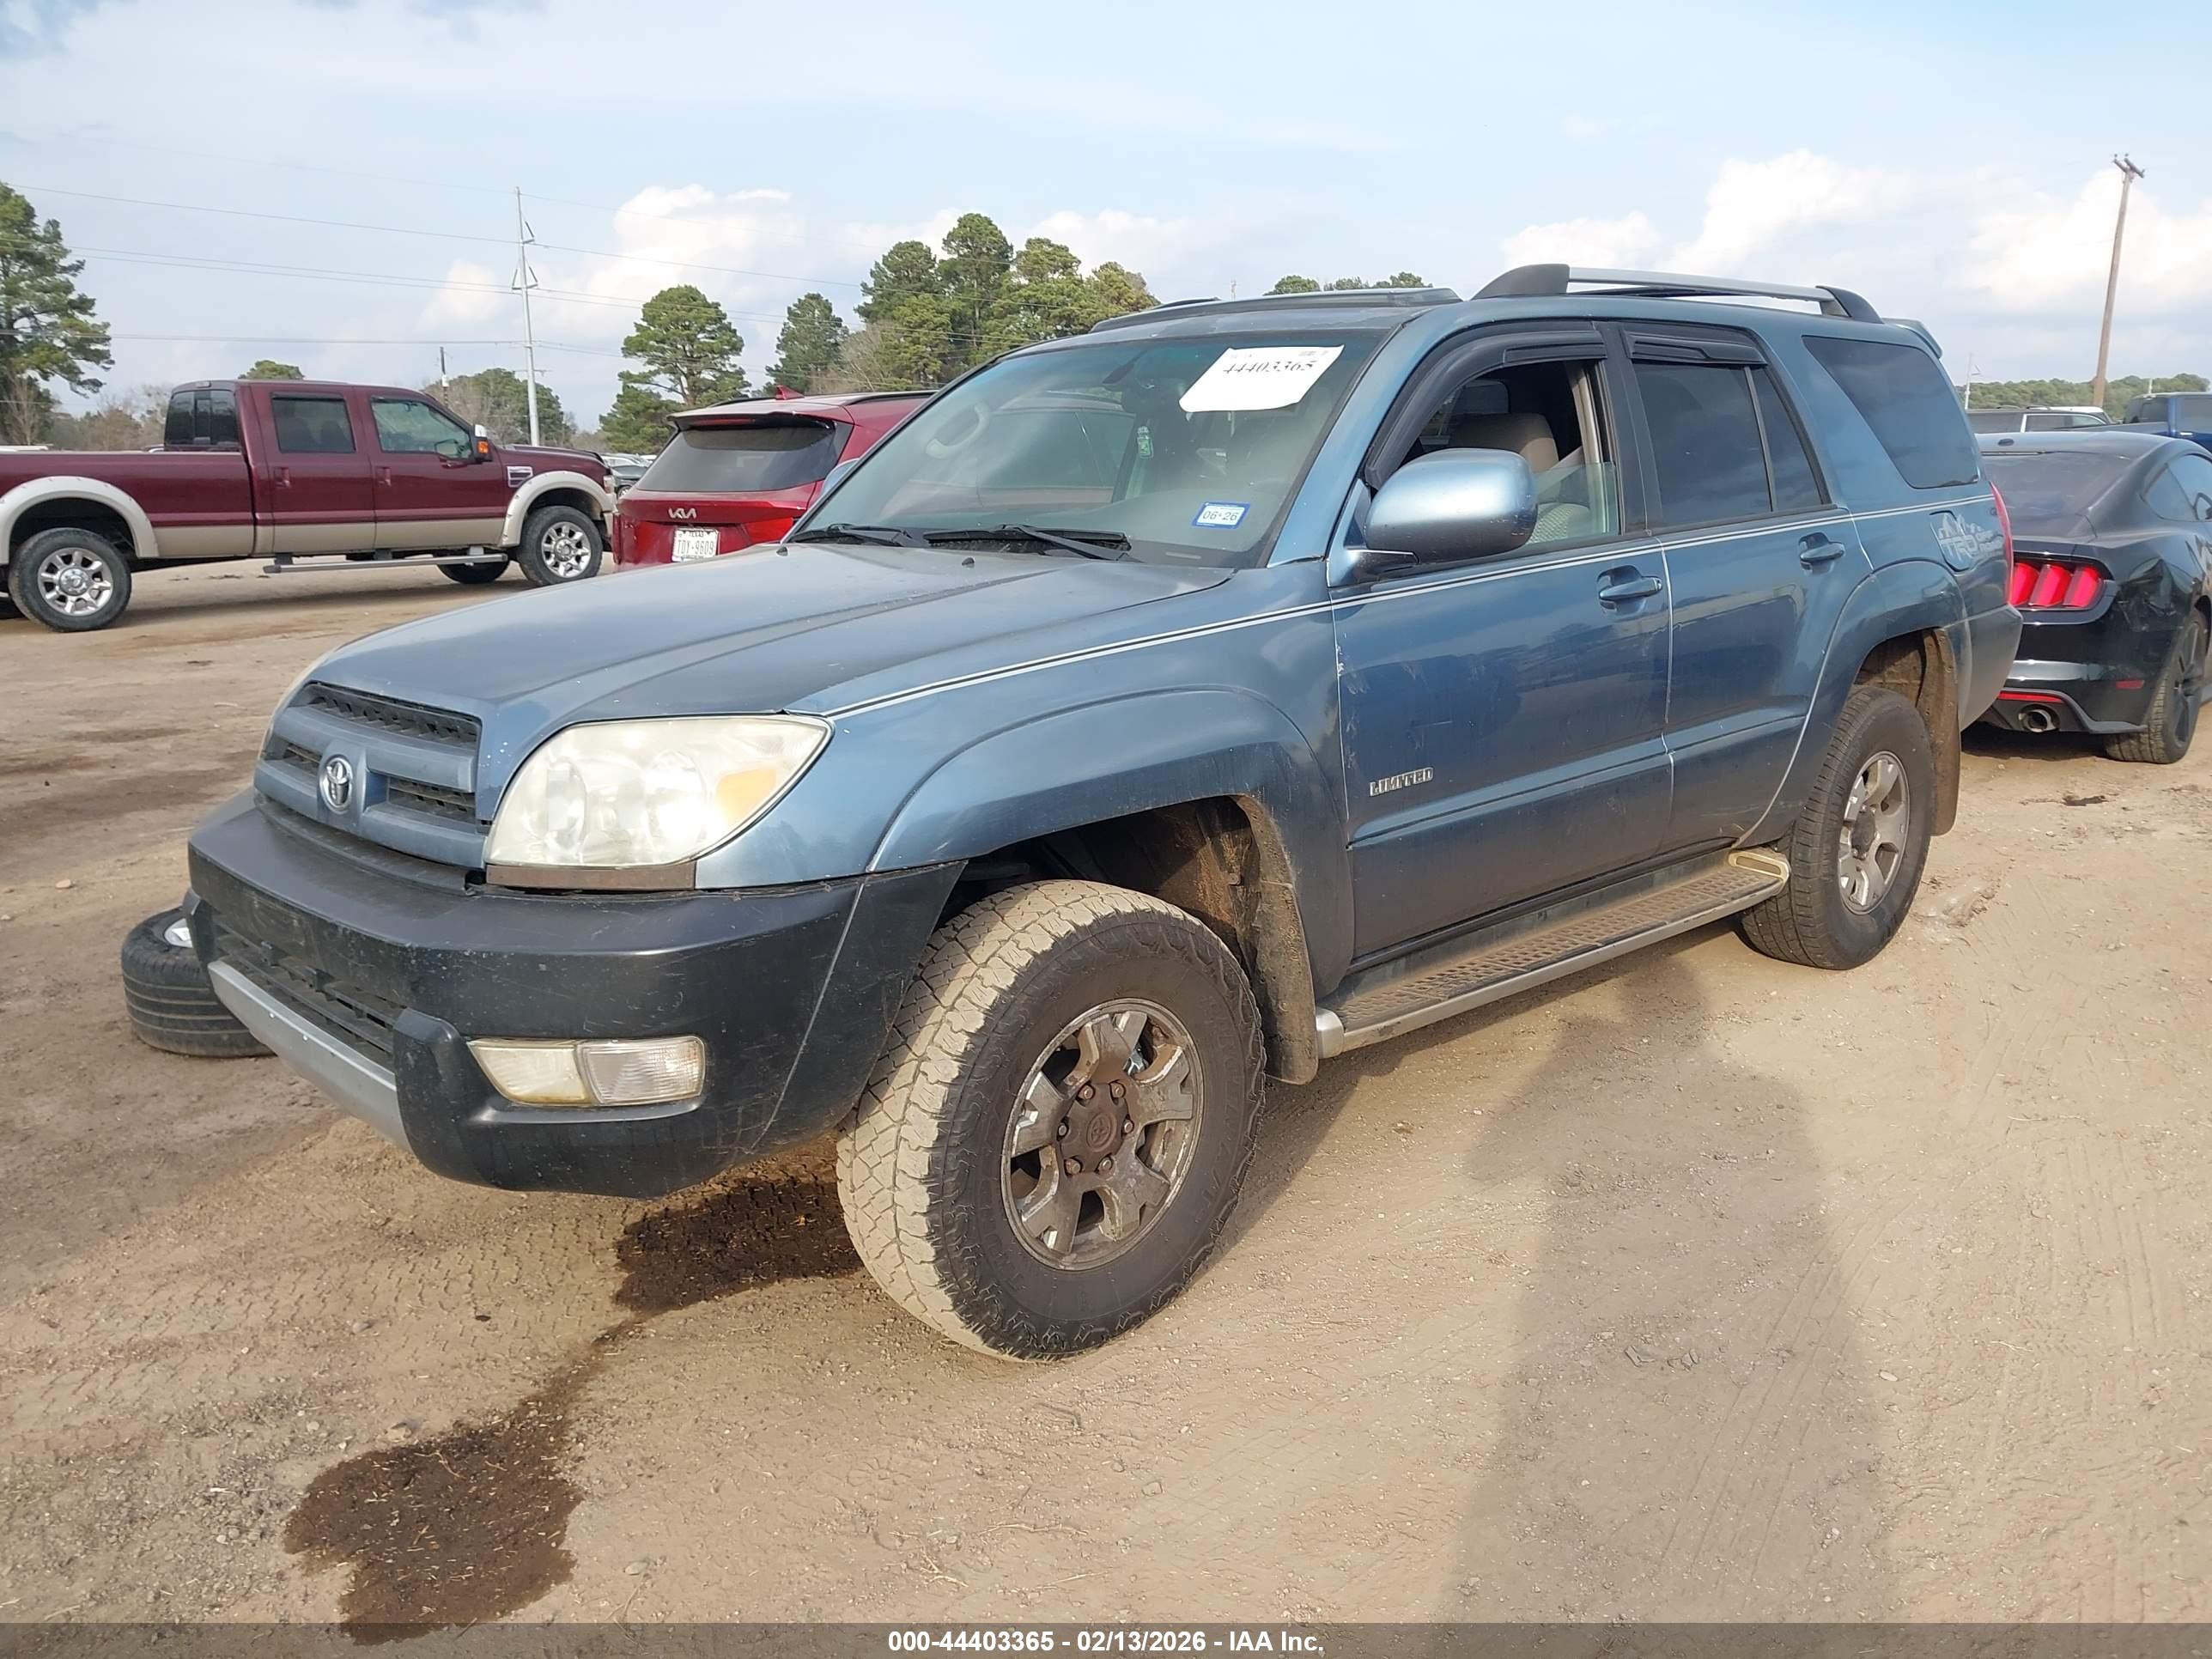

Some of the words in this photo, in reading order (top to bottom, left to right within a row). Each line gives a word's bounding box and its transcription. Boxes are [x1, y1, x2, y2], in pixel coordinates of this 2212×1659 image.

[1223, 360, 1318, 374] 44403365
[668, 507, 697, 519] KIA
[1370, 767, 1434, 797] LIMITED
